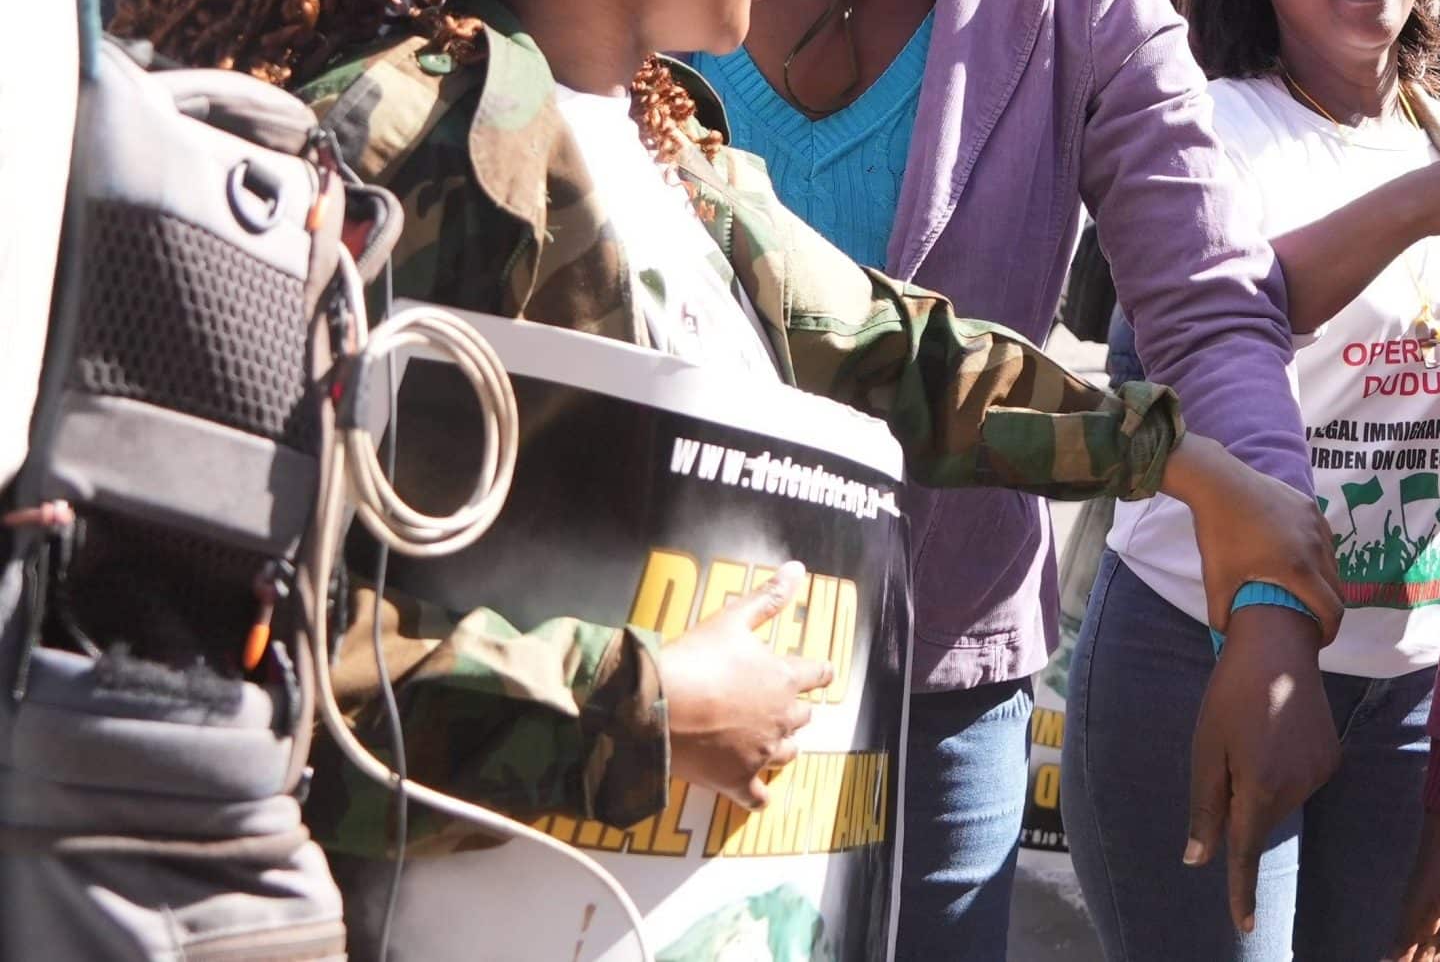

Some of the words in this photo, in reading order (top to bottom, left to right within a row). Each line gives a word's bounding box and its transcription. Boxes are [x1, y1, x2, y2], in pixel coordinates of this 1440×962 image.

[1312, 446, 1366, 470] URDEN
[1372, 449, 1394, 470] ON
[1396, 449, 1426, 470] OUR
